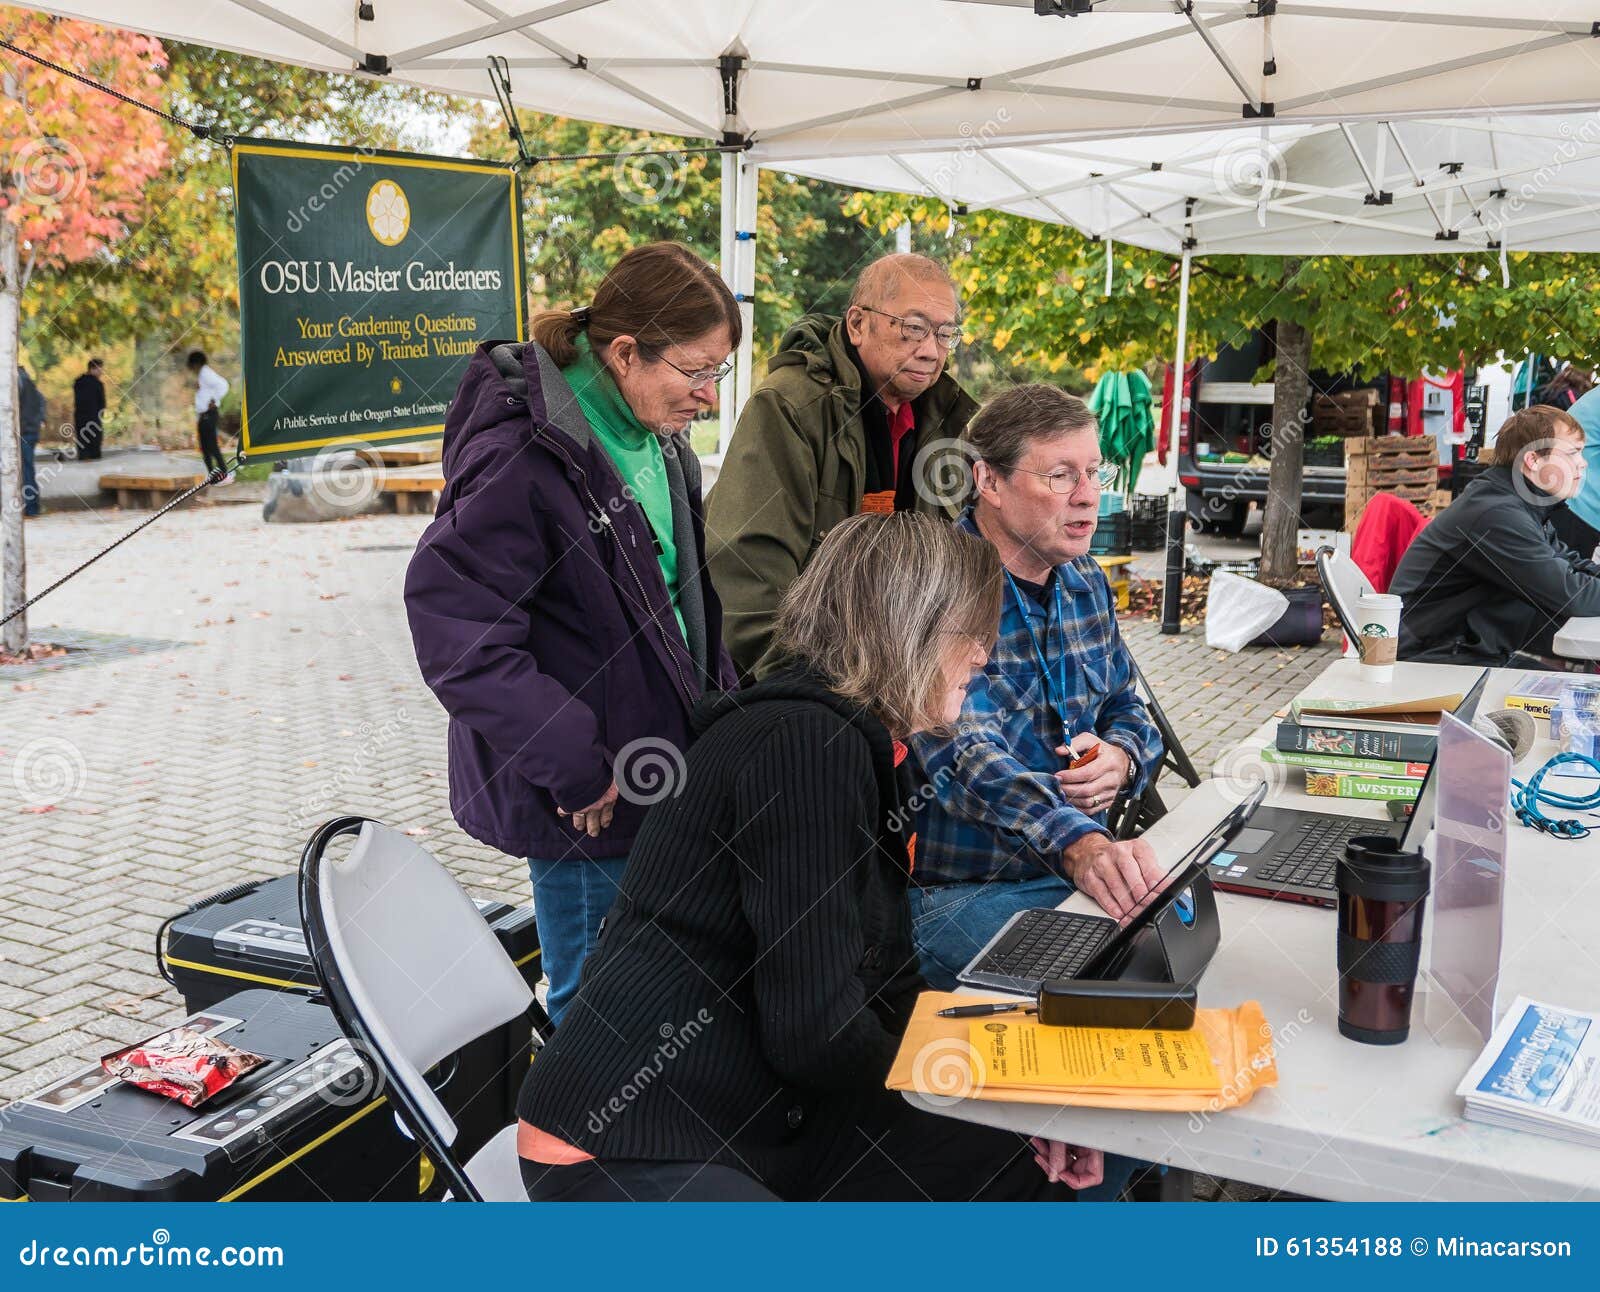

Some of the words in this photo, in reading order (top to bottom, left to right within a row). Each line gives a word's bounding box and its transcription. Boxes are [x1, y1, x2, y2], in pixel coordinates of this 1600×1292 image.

[261, 260, 322, 294] OSU
[329, 261, 401, 293] Master
[406, 261, 501, 292] Gardeners
[297, 317, 334, 339] Your
[338, 314, 411, 340] Gardening
[414, 313, 476, 334] Questions
[274, 346, 351, 368] Answered
[356, 344, 374, 368] By
[380, 339, 428, 360] Trained
[273, 418, 281, 431] A
[283, 415, 308, 429] Public
[309, 412, 338, 427] Service
[339, 410, 348, 423] of
[350, 410, 363, 422] the
[364, 408, 392, 423] Oregon
[393, 405, 411, 417] State
[413, 402, 447, 415] University
[1523, 702, 1542, 714] Home
